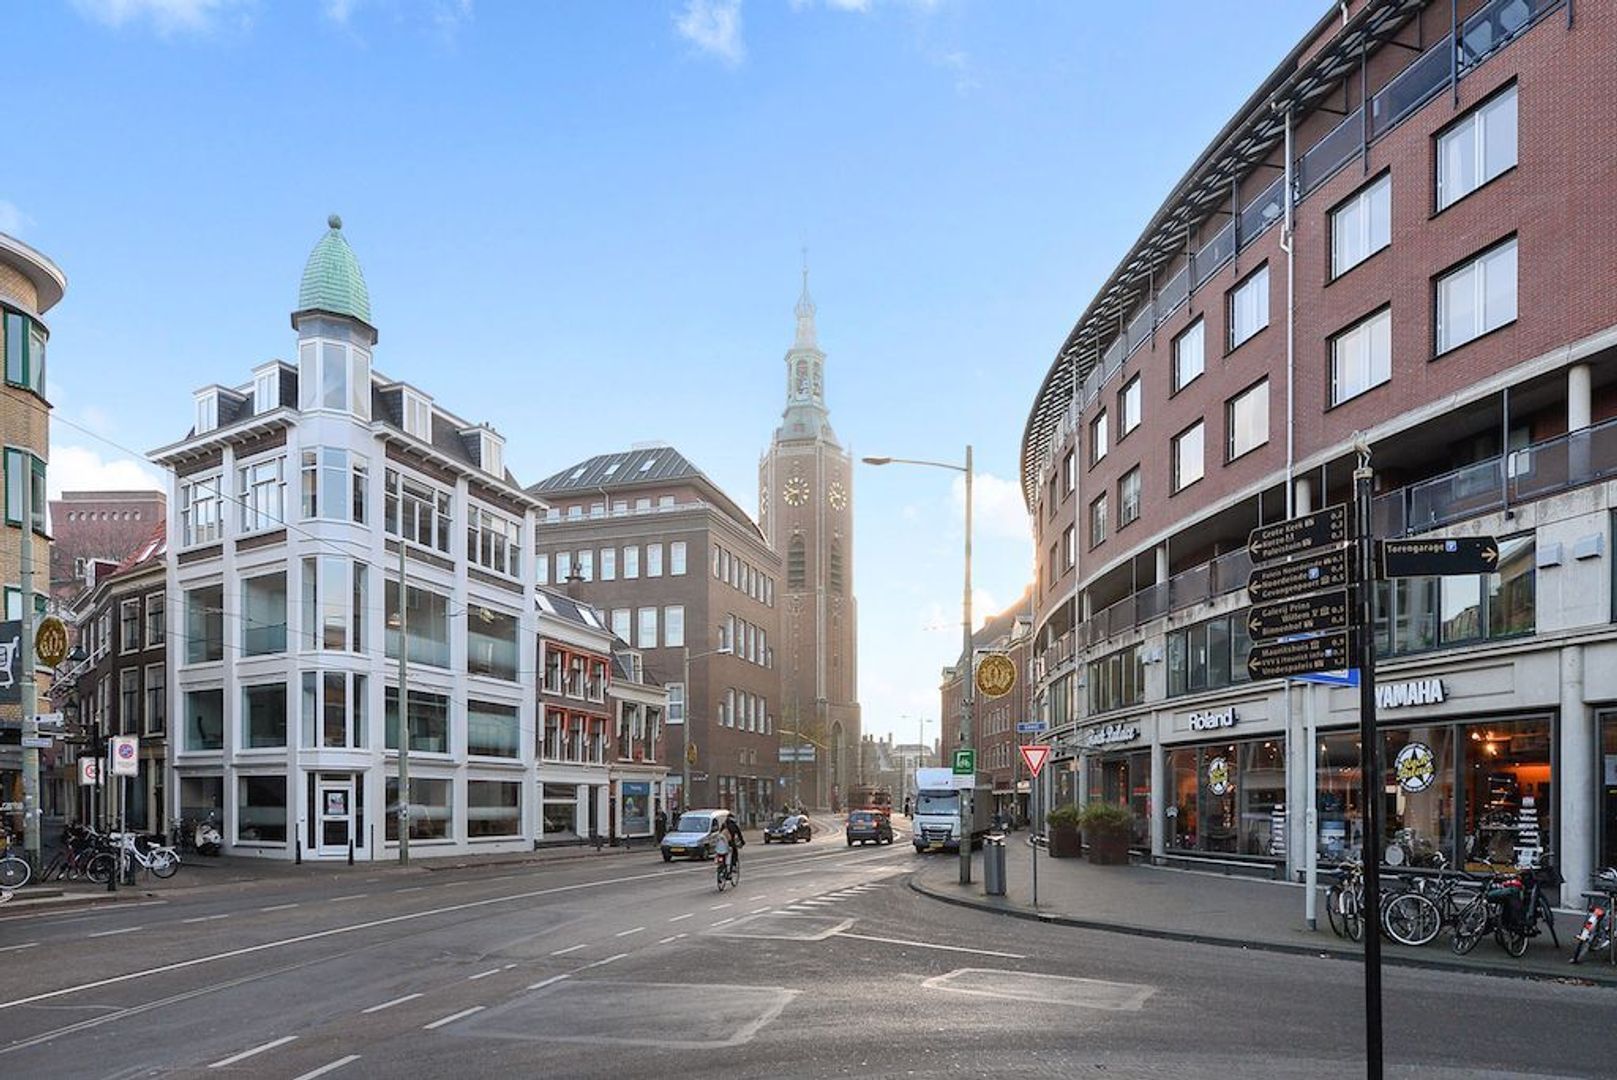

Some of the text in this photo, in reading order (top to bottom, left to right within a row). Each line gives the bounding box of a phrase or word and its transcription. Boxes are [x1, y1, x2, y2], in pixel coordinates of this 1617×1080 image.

[1285, 521, 1303, 532] Kerk
[1386, 544, 1444, 554] Torengarage
[1262, 573, 1307, 588] Noordeinde
[1375, 679, 1443, 708] YAMAHA
[1189, 707, 1234, 731] Roland
